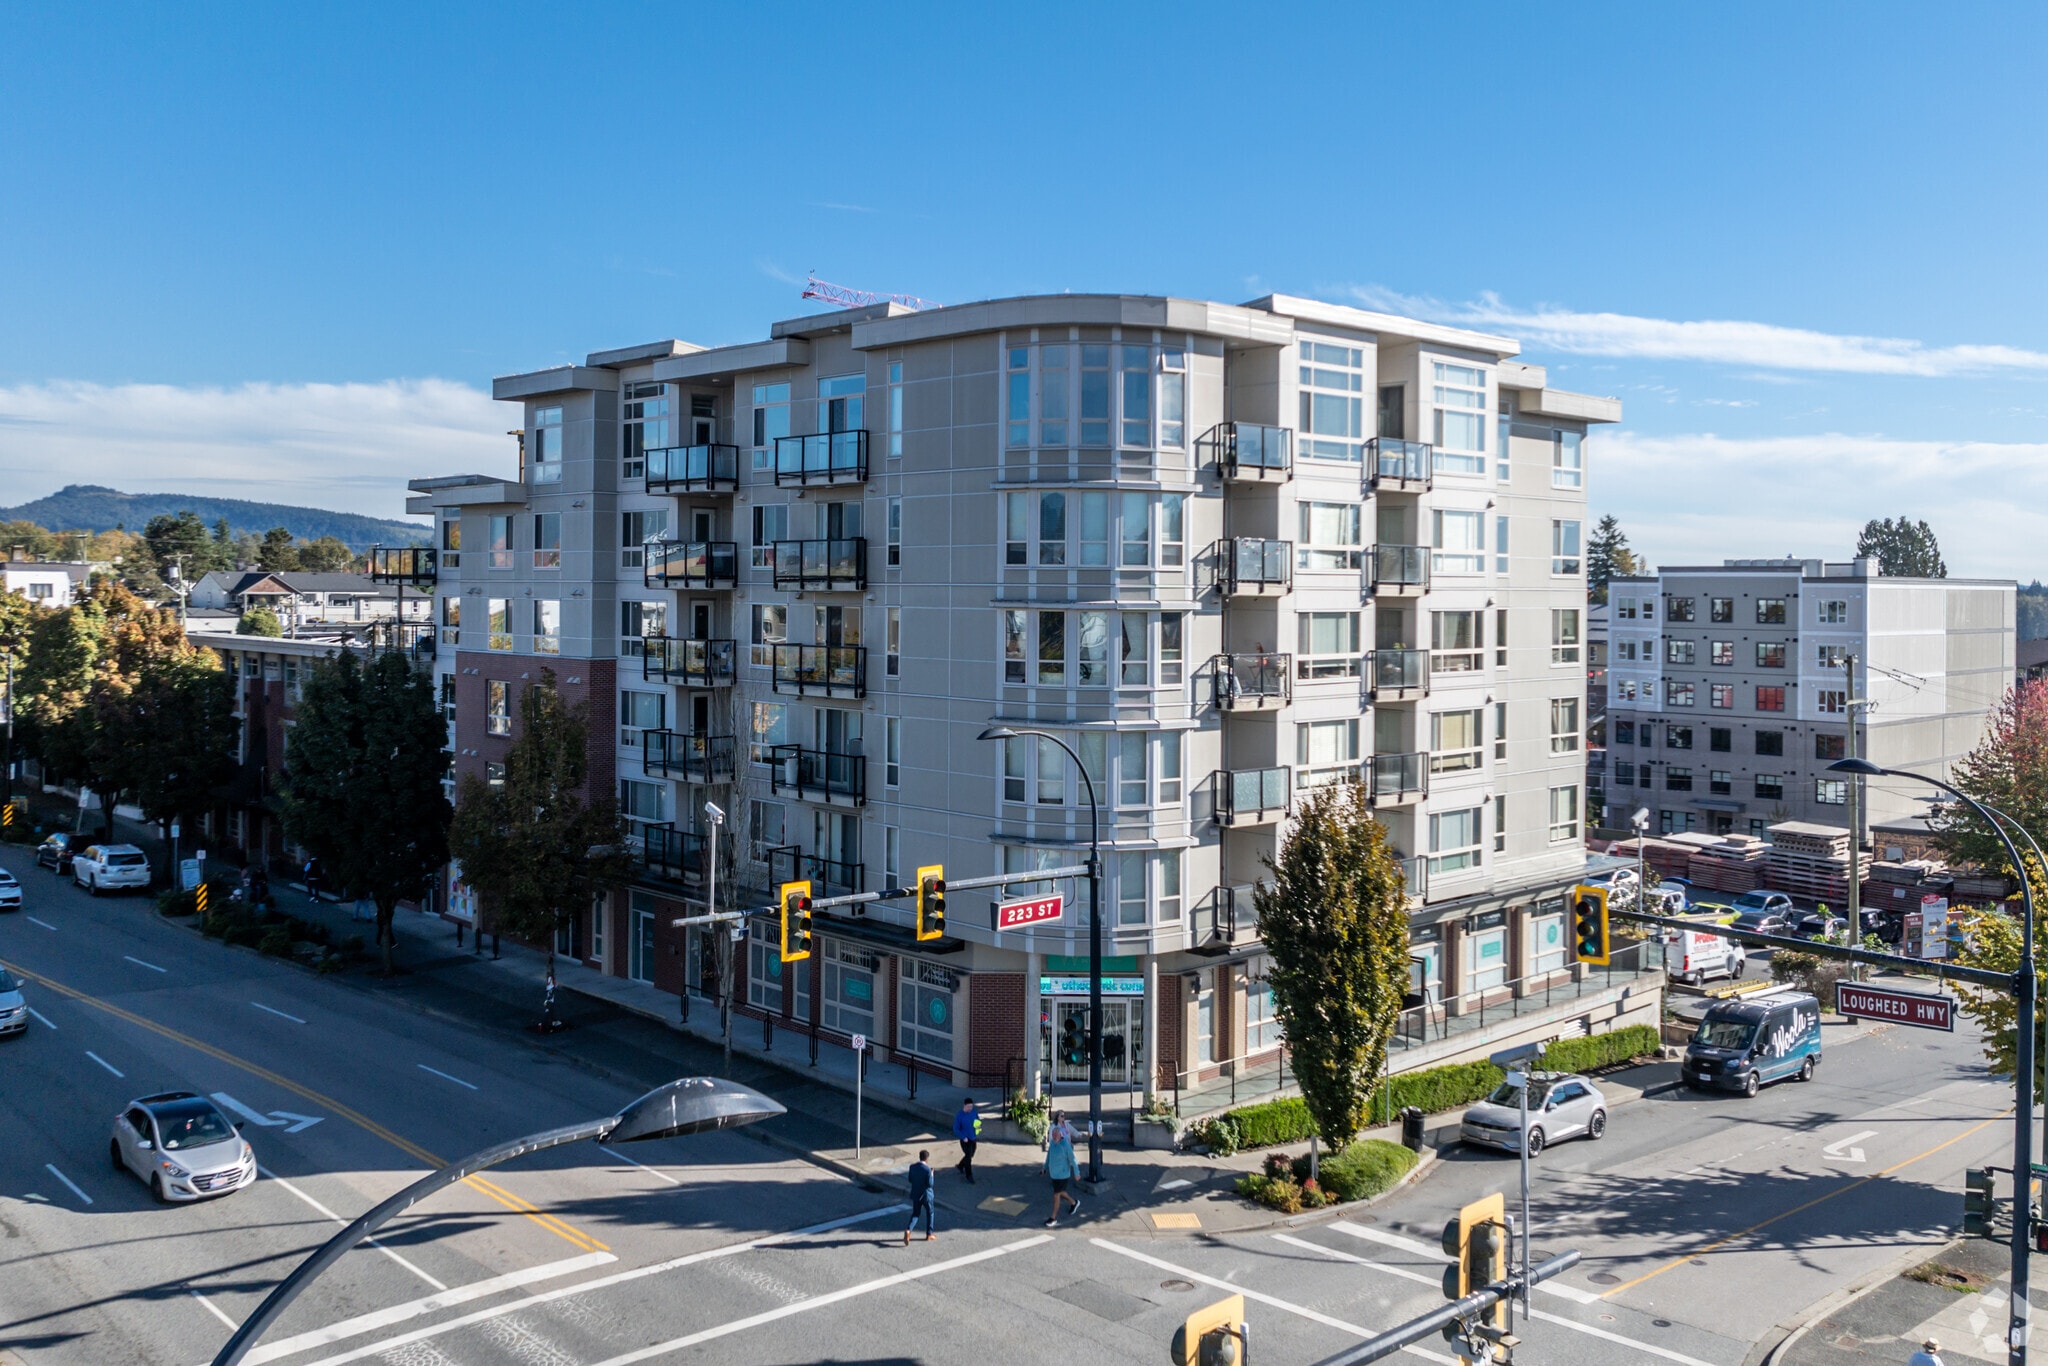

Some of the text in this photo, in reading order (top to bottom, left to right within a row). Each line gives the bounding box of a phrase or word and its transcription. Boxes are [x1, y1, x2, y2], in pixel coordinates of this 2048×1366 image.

[1008, 903, 1053, 922] 223 ST
[1843, 994, 1945, 1021] LOUGHEED HWY
[1771, 1007, 1807, 1058] Woola
